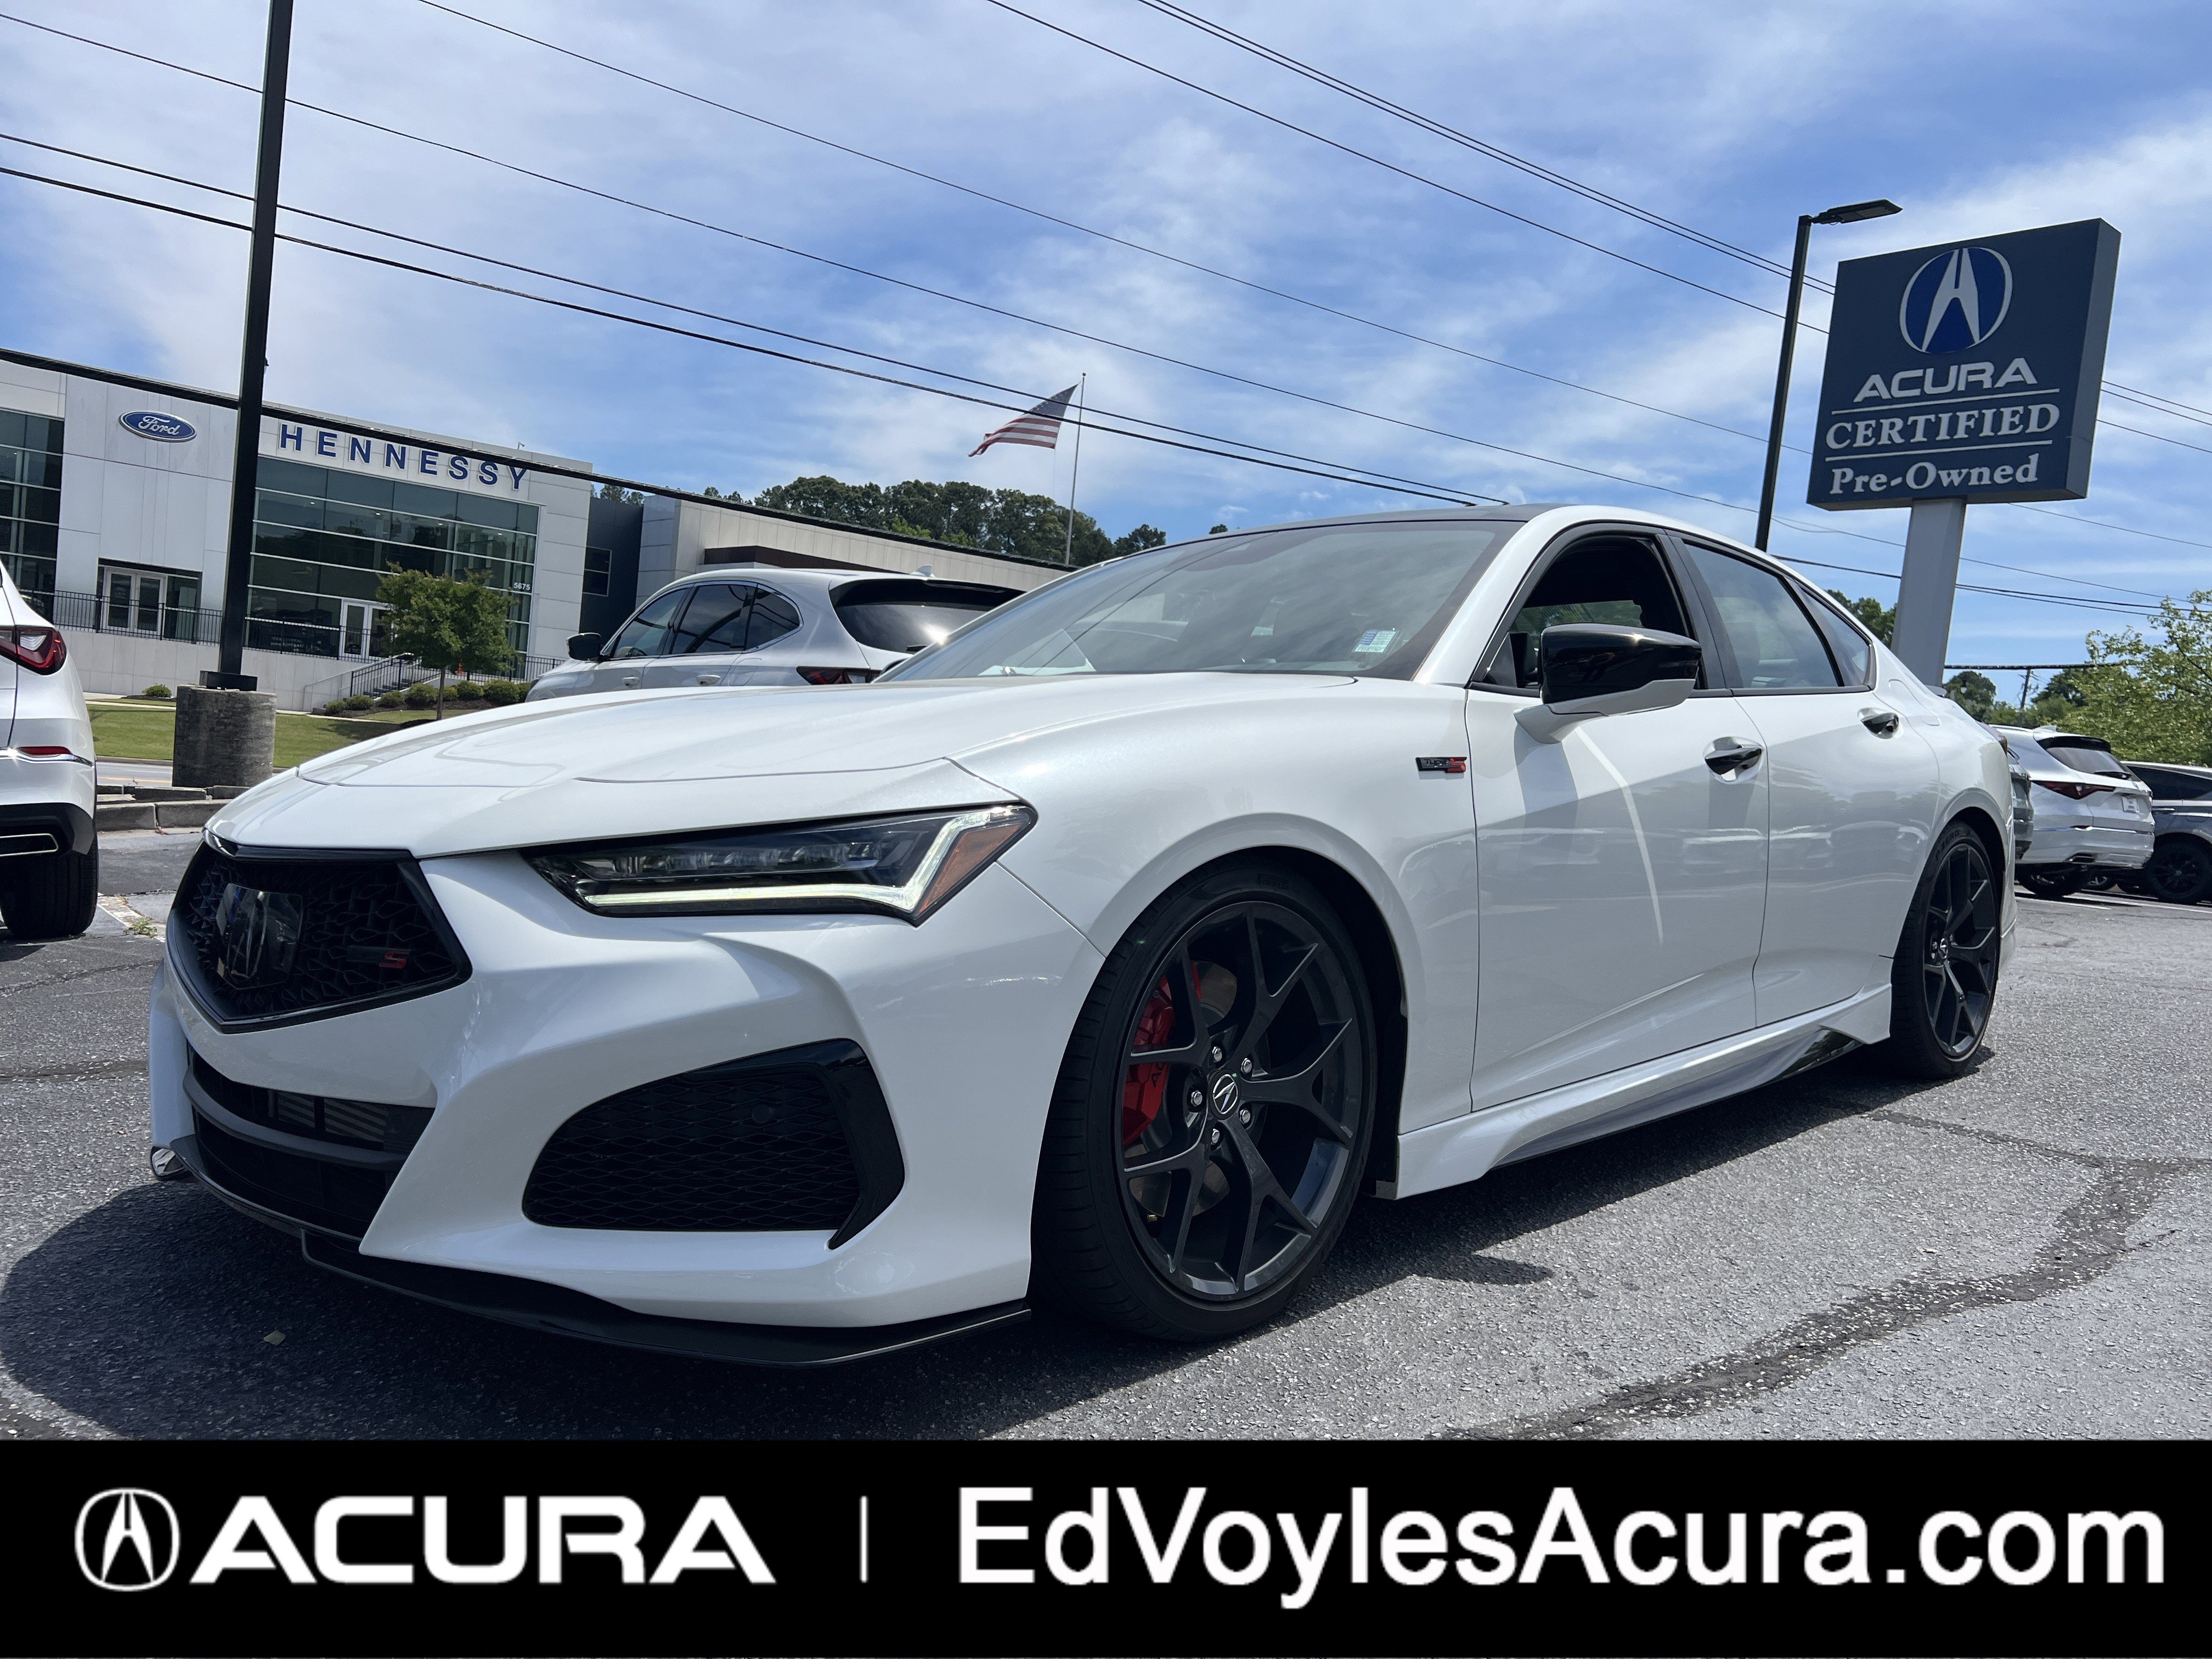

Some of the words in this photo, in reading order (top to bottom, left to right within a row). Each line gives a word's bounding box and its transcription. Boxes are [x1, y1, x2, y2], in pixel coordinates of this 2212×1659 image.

[1853, 357, 2038, 403] ACURA
[138, 415, 180, 436] Ford
[1825, 403, 2060, 449] CERTIFIED
[279, 424, 527, 490] HENNESSY
[1830, 453, 2039, 494] Pre-Owned
